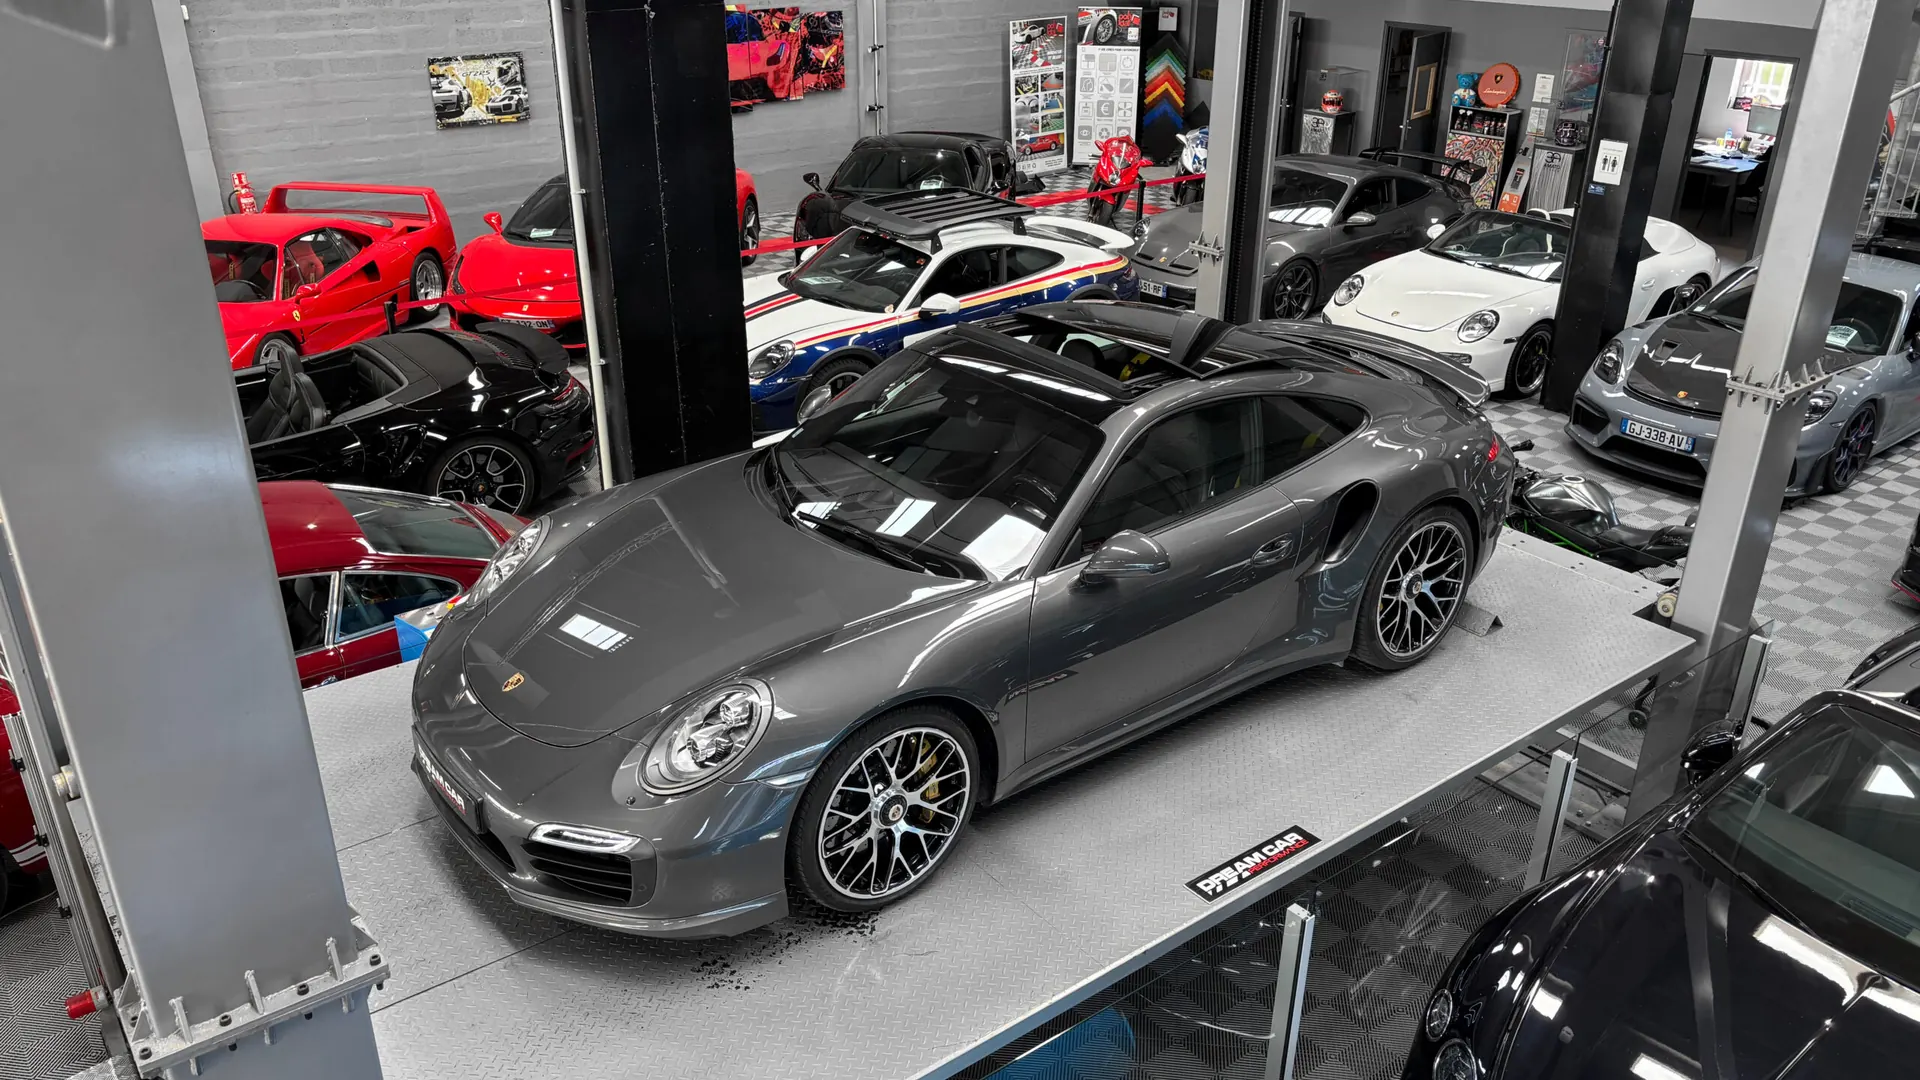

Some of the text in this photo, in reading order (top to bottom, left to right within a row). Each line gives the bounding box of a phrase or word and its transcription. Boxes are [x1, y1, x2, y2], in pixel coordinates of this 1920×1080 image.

[1628, 422, 1685, 447] GJ-338-AV
[444, 781, 465, 810] CAR
[1196, 832, 1304, 894] DREAM CAR
[1248, 839, 1309, 875] PERFORMANCE
